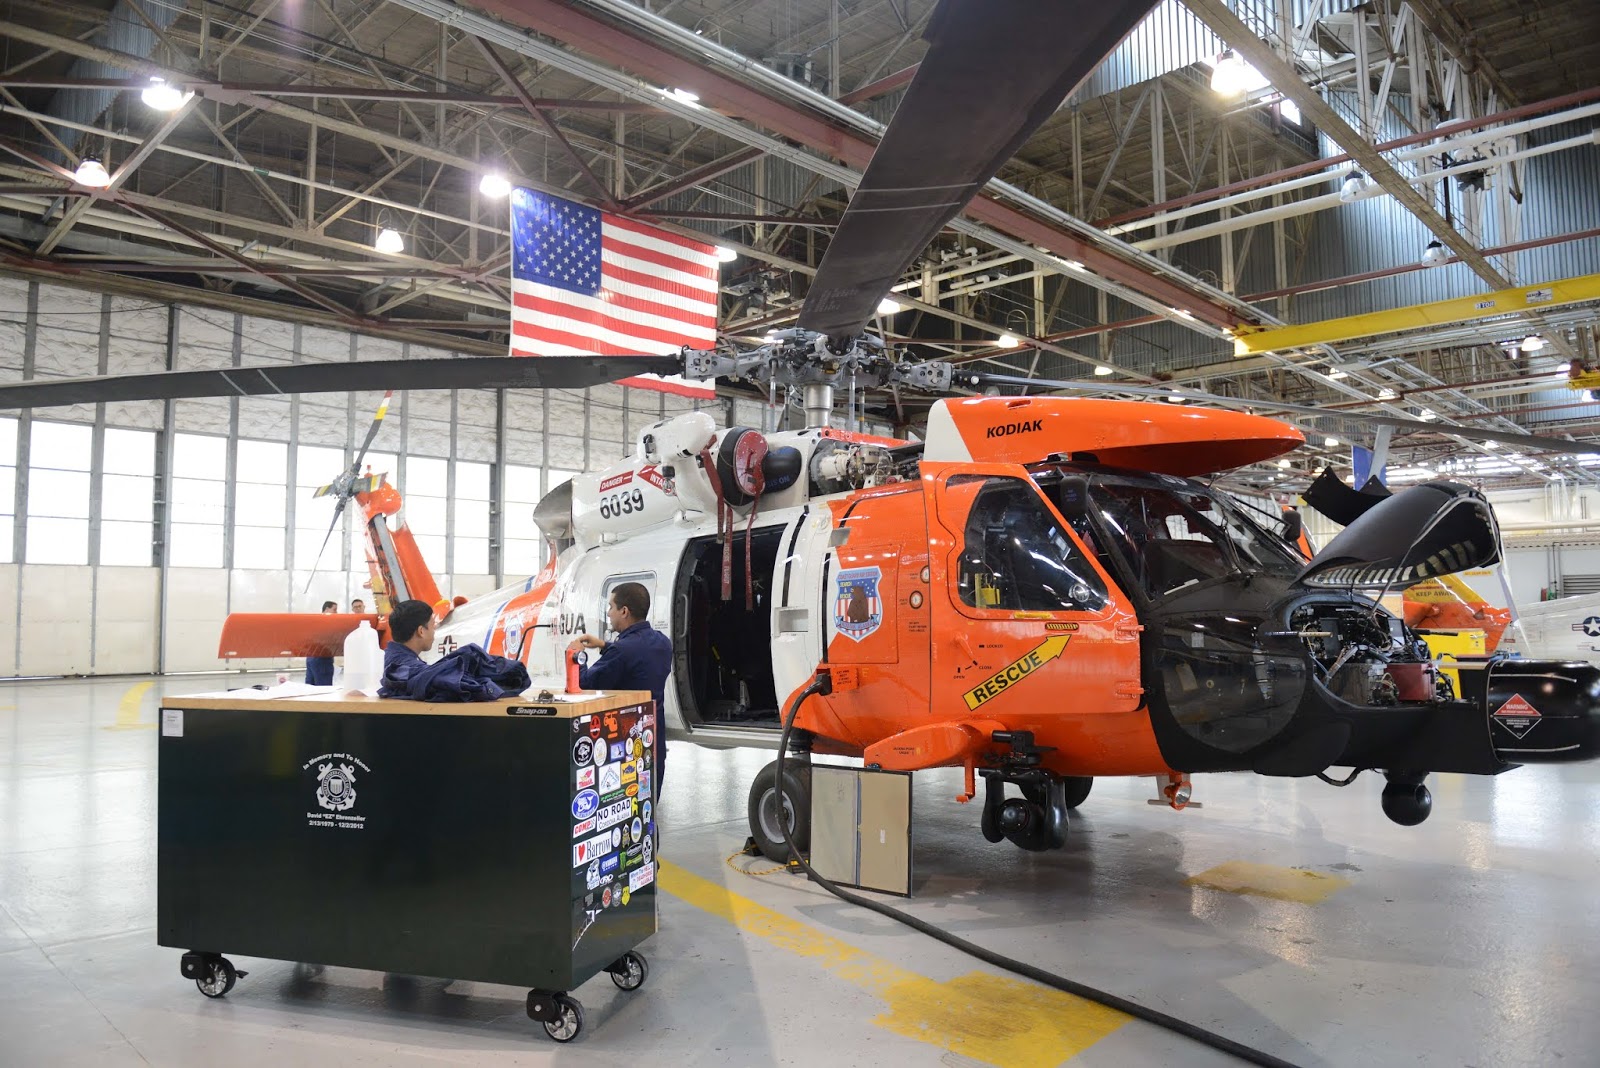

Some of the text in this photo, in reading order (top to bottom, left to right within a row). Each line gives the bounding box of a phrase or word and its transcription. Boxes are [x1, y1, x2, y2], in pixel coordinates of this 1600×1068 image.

[987, 420, 1042, 438] KODIAK
[601, 477, 623, 489] DANGER
[600, 488, 644, 519] 6039
[560, 612, 586, 635] GUA
[972, 651, 1042, 703] RESCUE
[515, 707, 548, 715] Snap-on
[303, 763, 310, 771] In
[308, 753, 333, 765] Memory
[345, 753, 353, 761] To
[354, 757, 371, 773] Honor
[597, 809, 609, 820] NO
[611, 800, 630, 815] ROAD
[574, 846, 578, 866] I
[586, 837, 611, 860] Barrow
